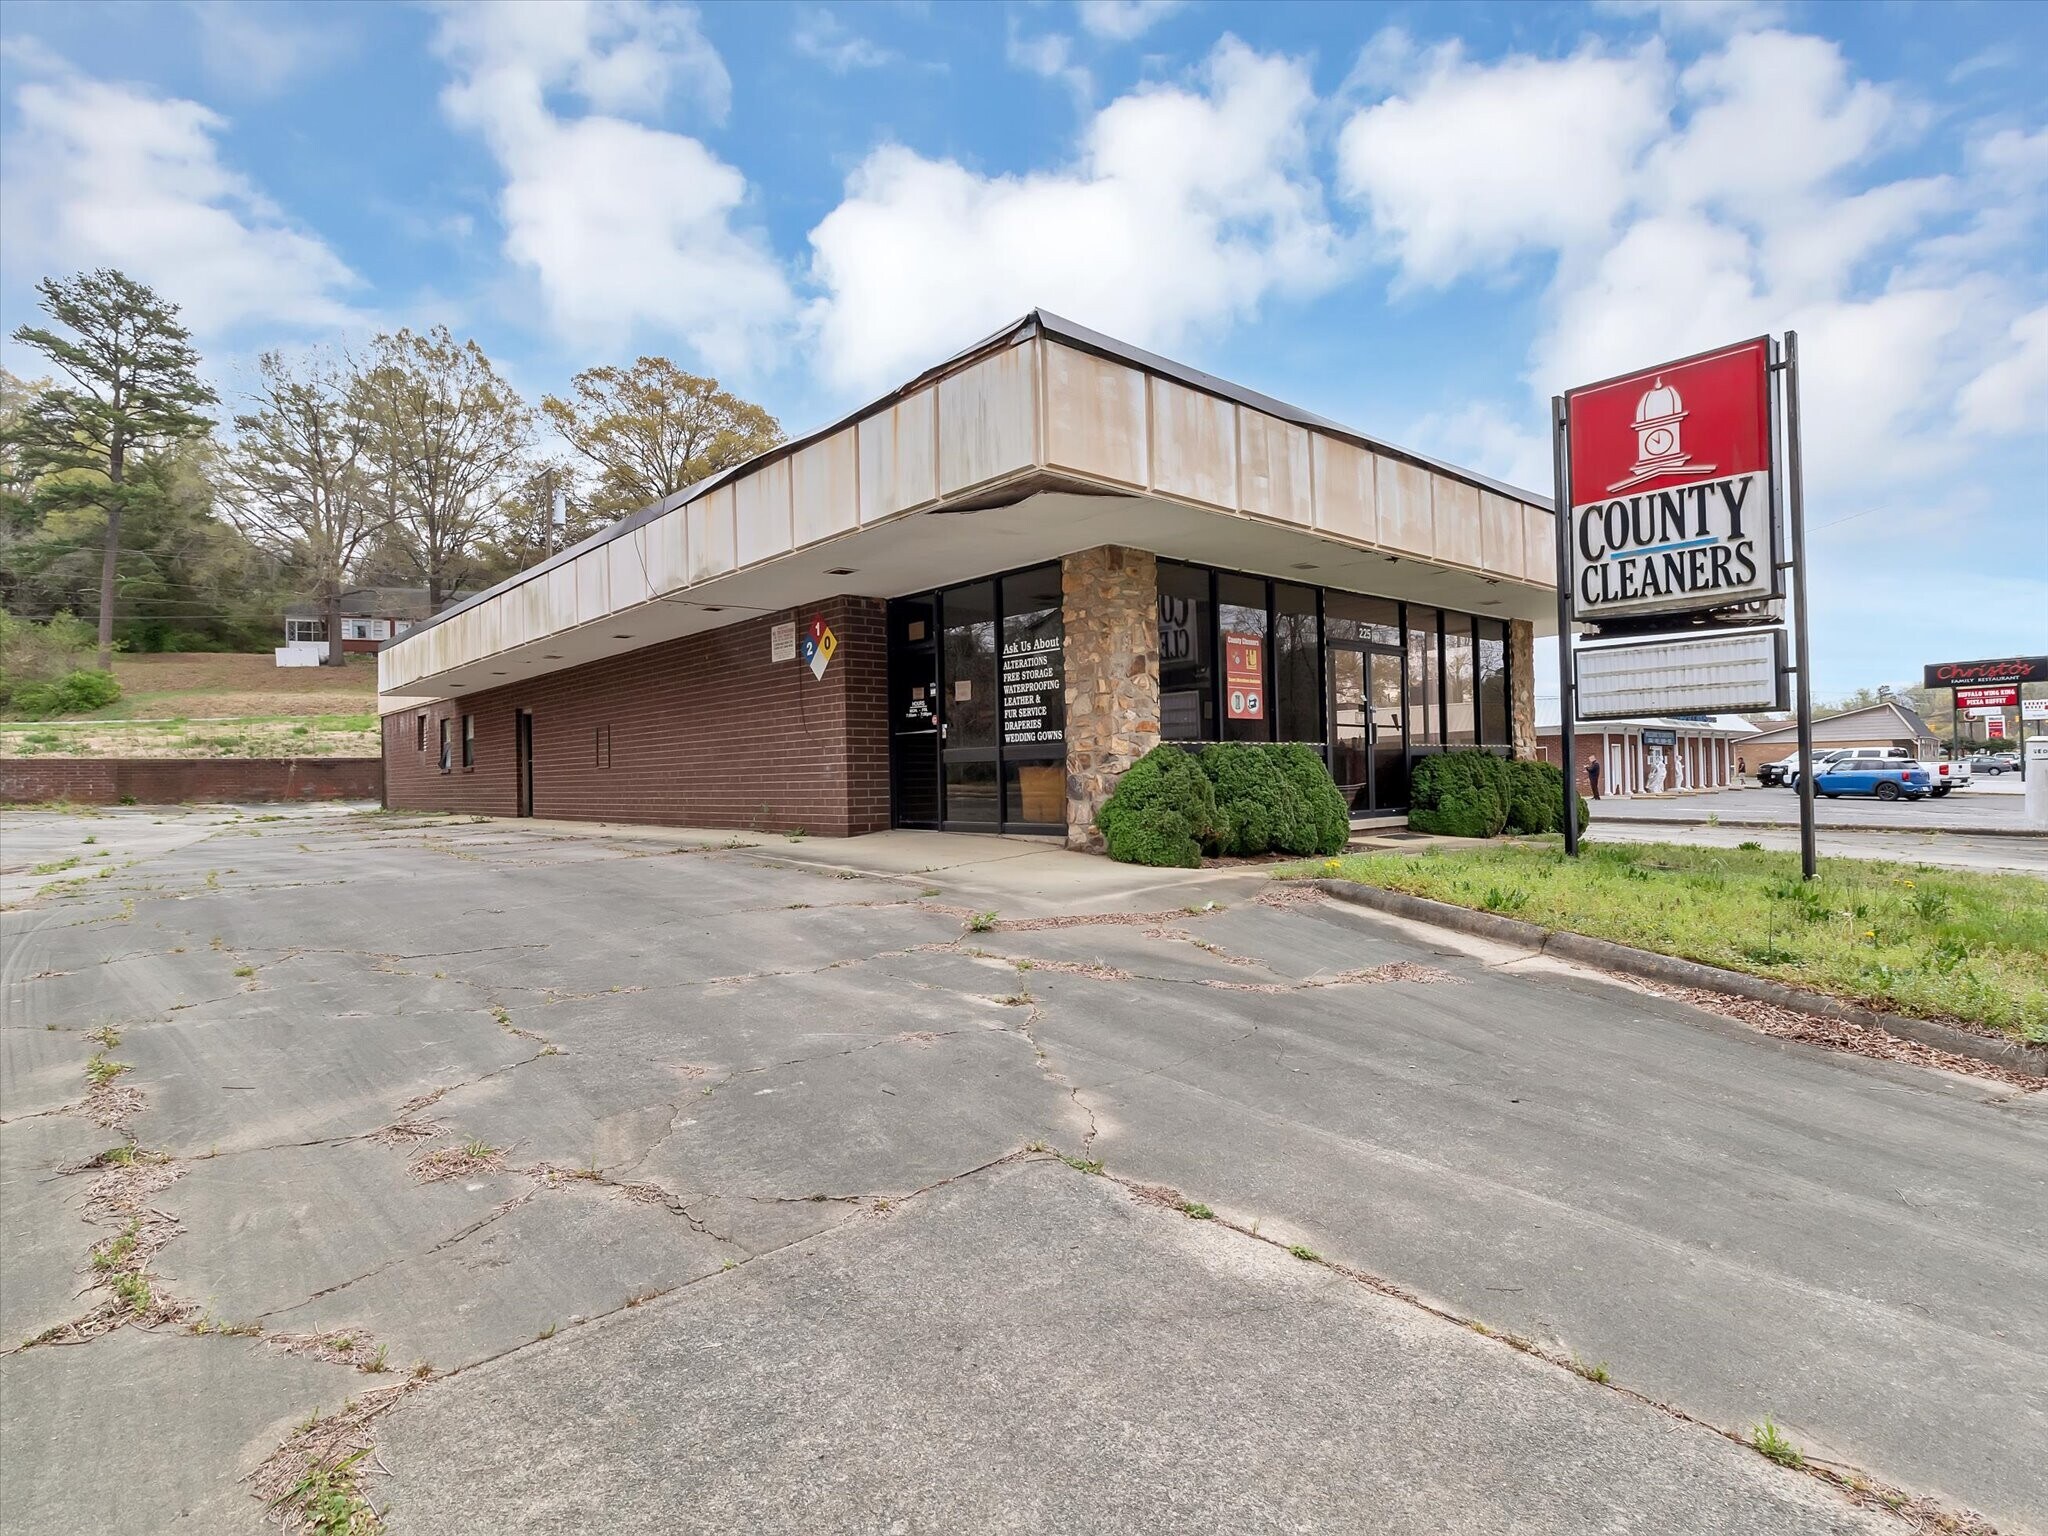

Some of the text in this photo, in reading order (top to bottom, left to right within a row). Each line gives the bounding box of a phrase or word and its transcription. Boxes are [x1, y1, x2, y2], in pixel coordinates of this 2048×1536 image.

[1579, 475, 1754, 562] COUNTY
[1581, 541, 1757, 606] CLEANERS
[815, 622, 821, 637] 1
[1359, 628, 1371, 639] 225
[806, 641, 813, 656] 2
[824, 635, 831, 650] 0
[1003, 637, 1060, 654] Ask Us About
[1003, 656, 1048, 670] ALTERATIONS
[1003, 668, 1054, 682] FREE STORAGE
[1004, 680, 1060, 694] WATERPROOFING
[1957, 690, 1983, 698] BUFFALO
[1004, 694, 1041, 706] LEATHER &
[1004, 706, 1047, 718] FUR SERVICE
[1005, 719, 1042, 730] DRAPERIES
[1005, 730, 1063, 743] WEDDING GOWNS
